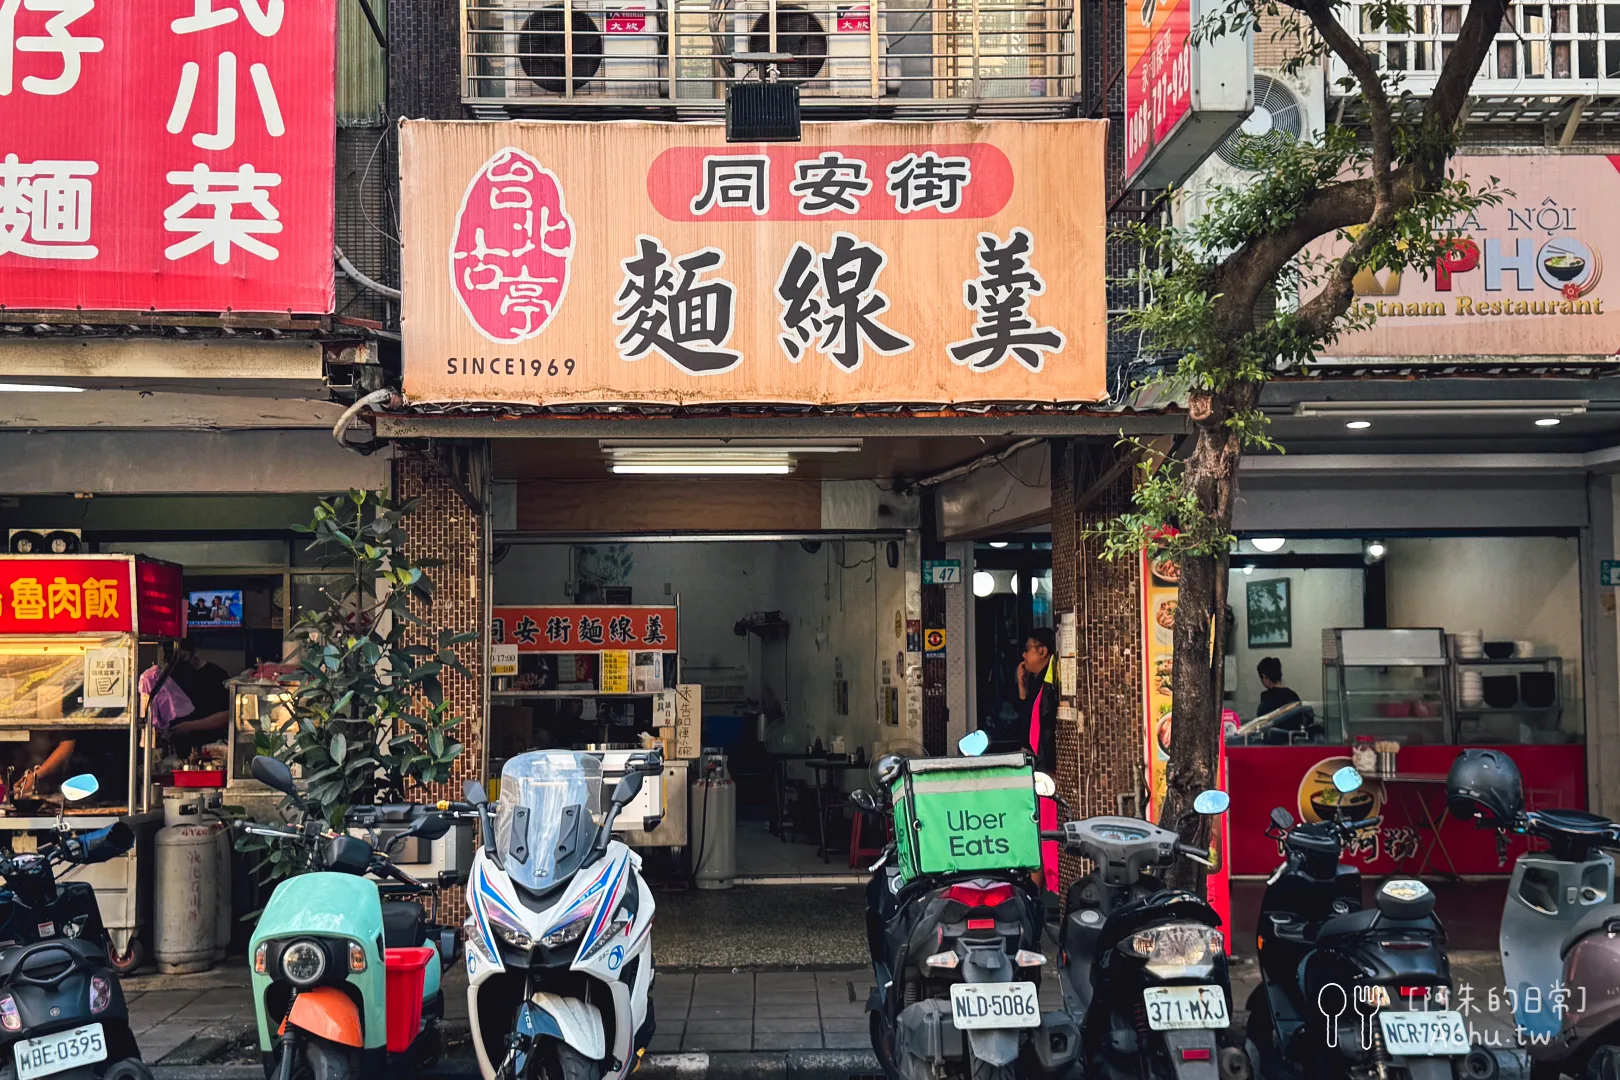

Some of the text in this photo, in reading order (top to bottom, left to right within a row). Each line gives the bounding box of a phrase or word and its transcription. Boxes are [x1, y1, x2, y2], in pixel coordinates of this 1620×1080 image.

[1129, 46, 1189, 159] 0968-727-928
[692, 153, 972, 215] 同安街
[613, 229, 1064, 375] 麵線羹
[1350, 295, 1604, 317] ietnam Restaurant
[939, 568, 954, 581] 47
[0, 576, 119, 619] 魯肉飯
[947, 809, 1007, 832] Uber
[950, 835, 1010, 857] Eats
